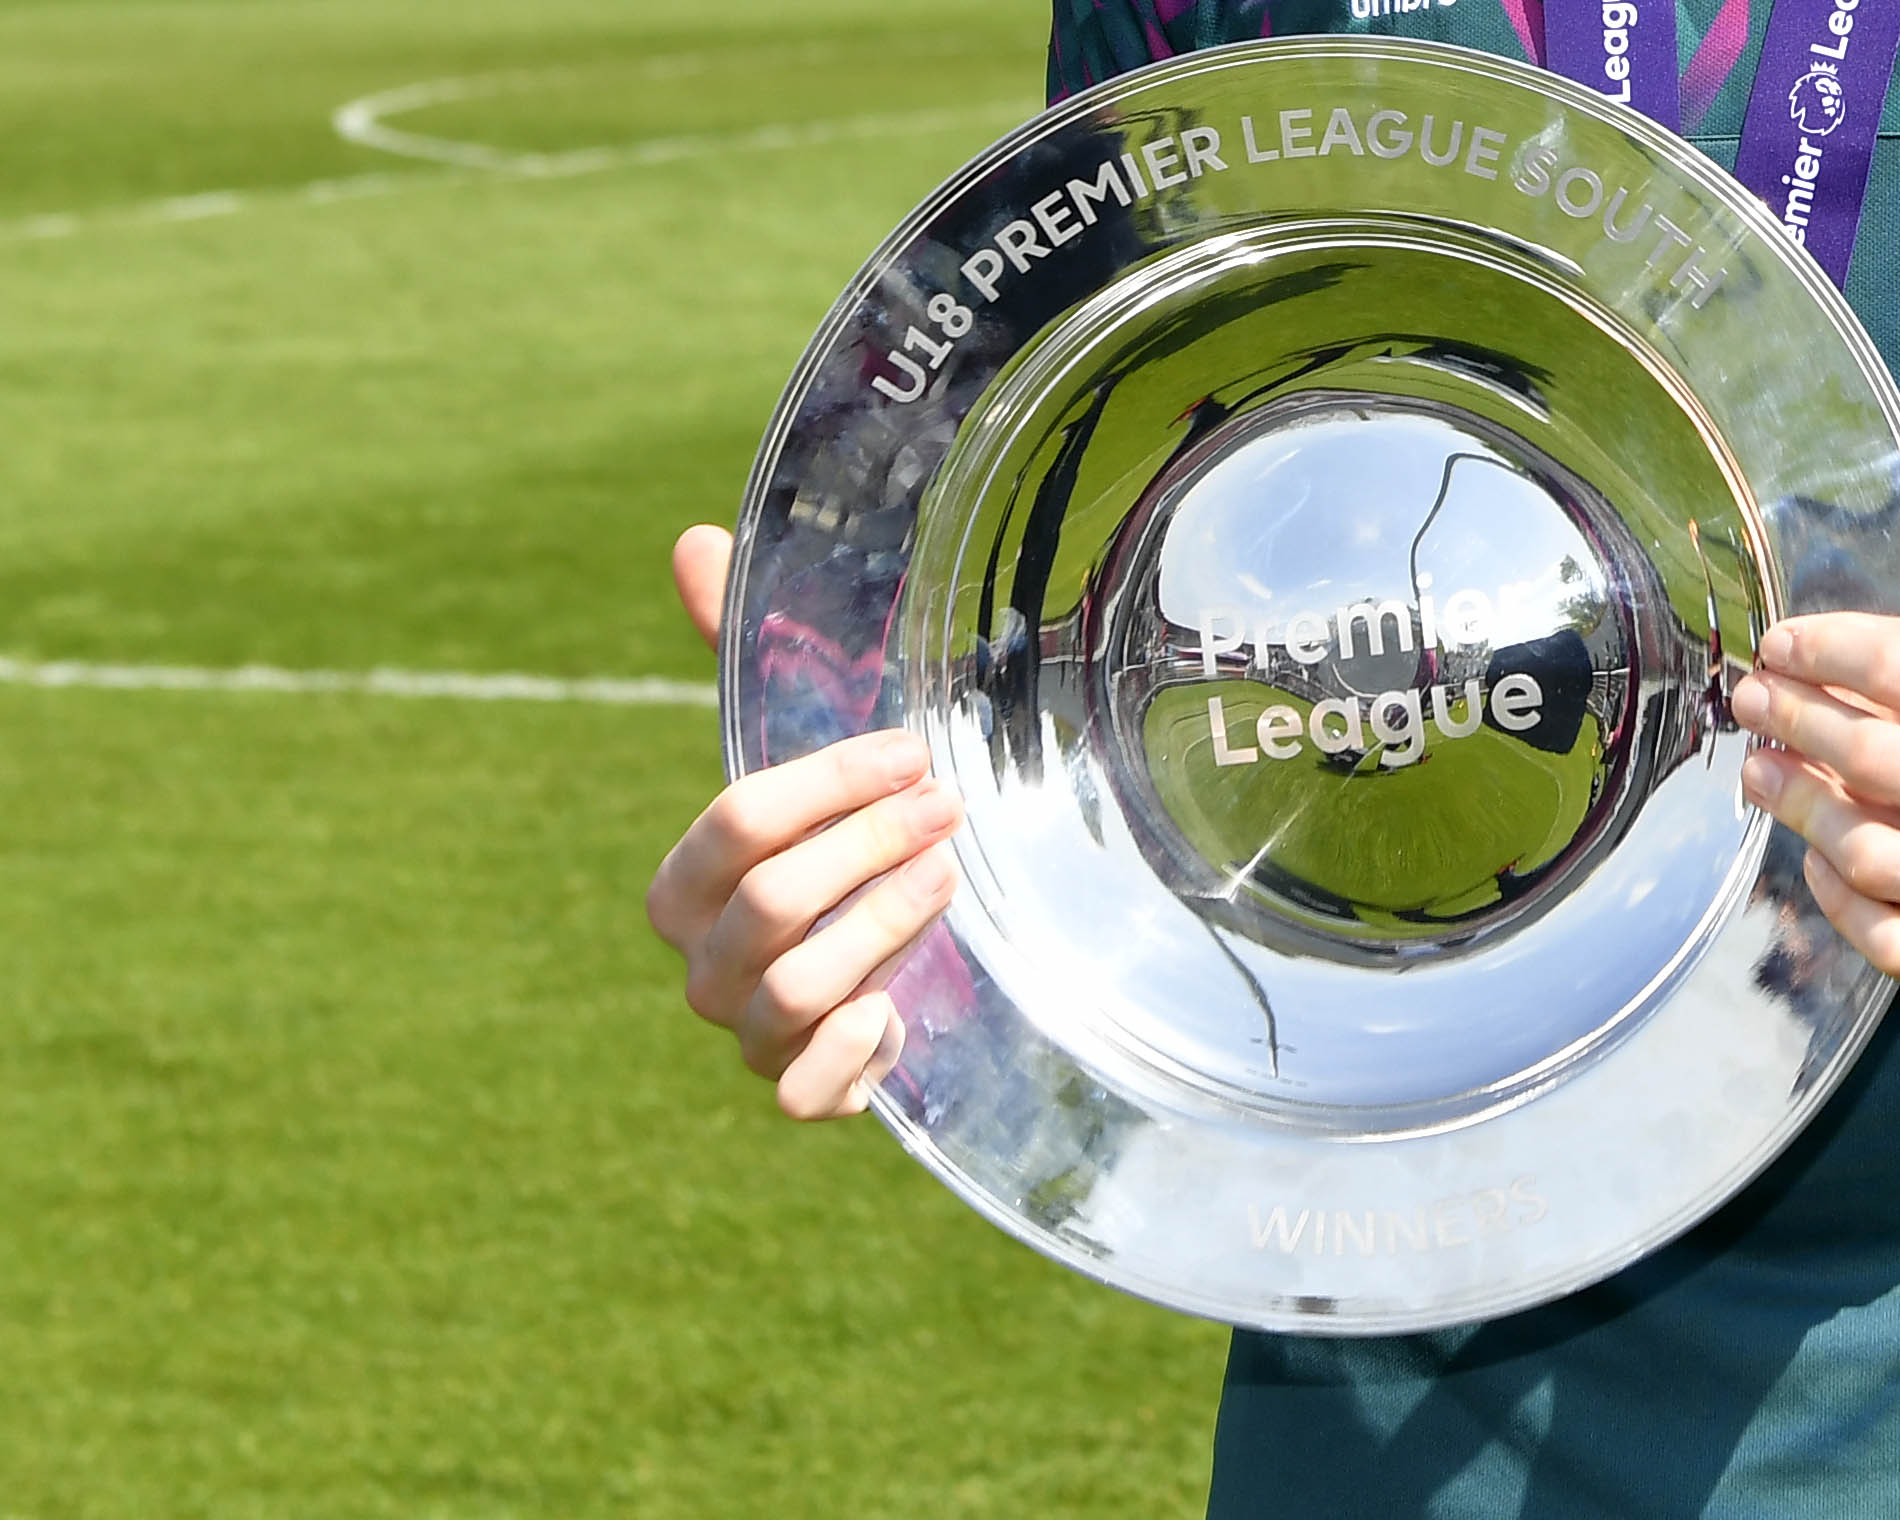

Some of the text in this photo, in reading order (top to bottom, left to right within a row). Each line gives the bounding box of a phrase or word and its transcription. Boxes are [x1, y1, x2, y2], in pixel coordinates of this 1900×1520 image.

[1781, 136, 1823, 247] emier
[871, 108, 1728, 404] U18 PREMIER LEAGUE SOUTH
[1207, 673, 1544, 767] League
[1247, 1175, 1549, 1256] WINNERS
